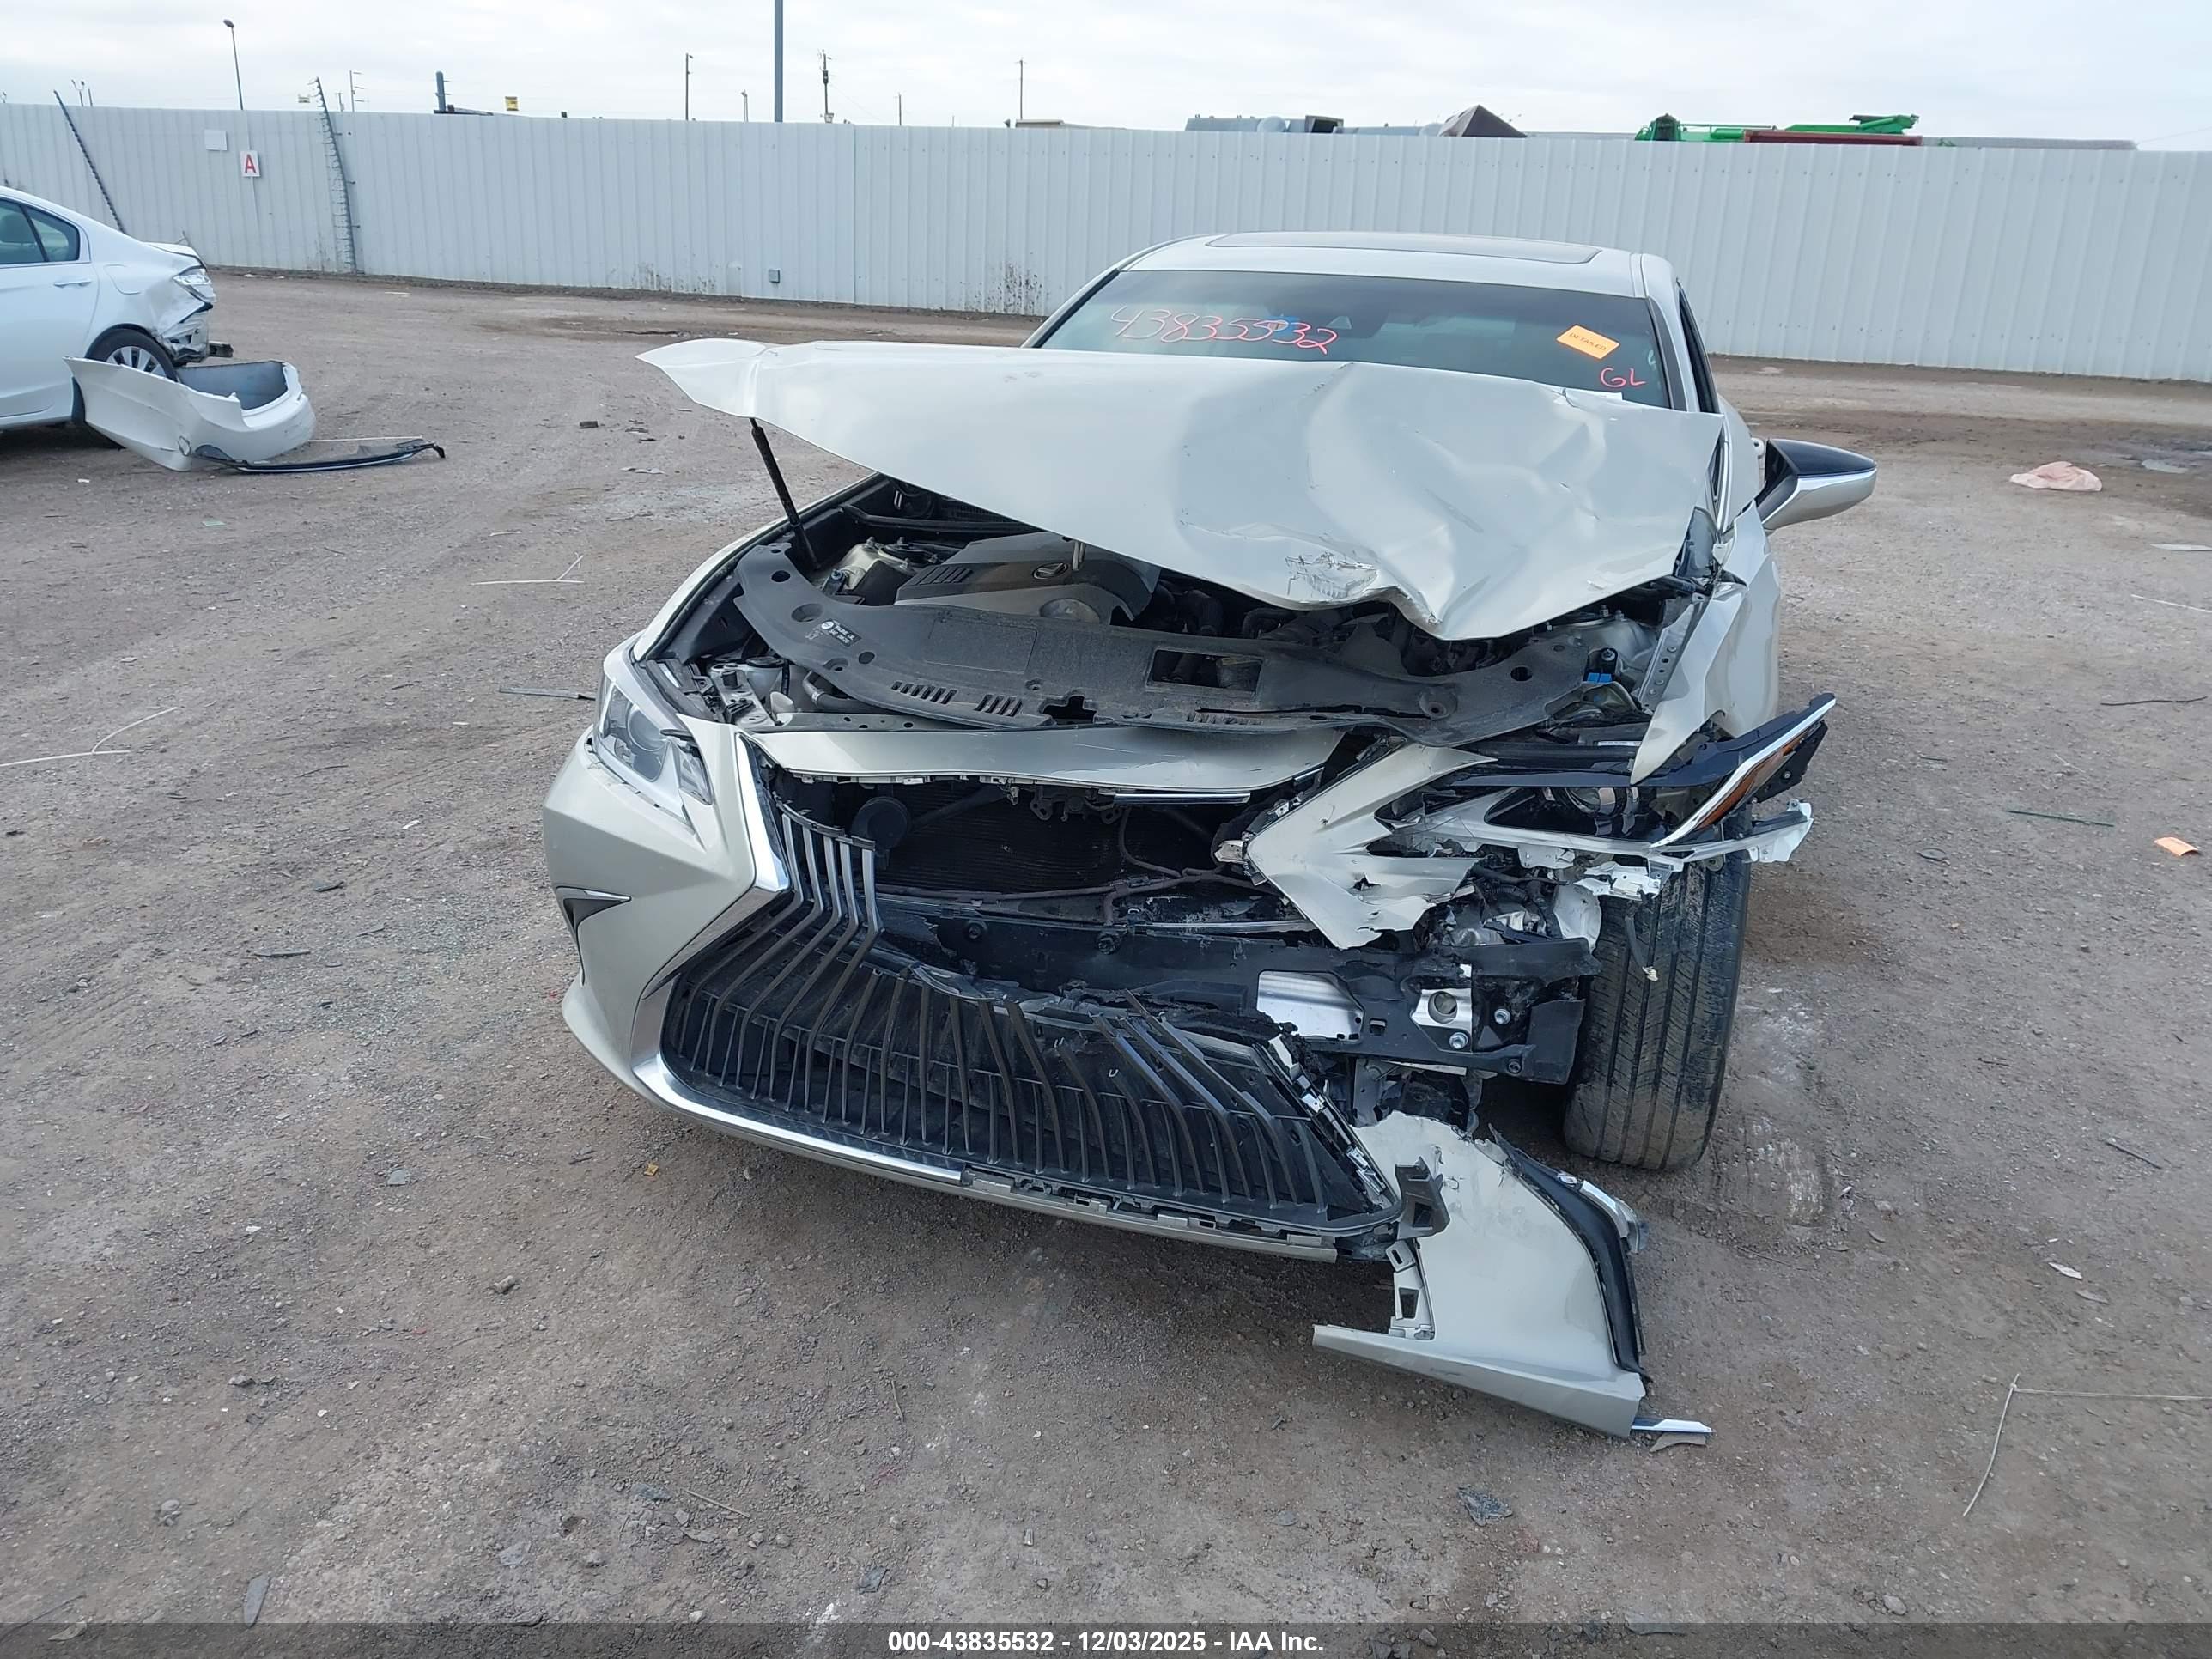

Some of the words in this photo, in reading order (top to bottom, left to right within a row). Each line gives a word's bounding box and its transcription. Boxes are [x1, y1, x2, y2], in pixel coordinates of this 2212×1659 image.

[245, 154, 256, 173] A
[1110, 305, 1339, 355] 43835532
[1569, 332, 1607, 352] DETAILED
